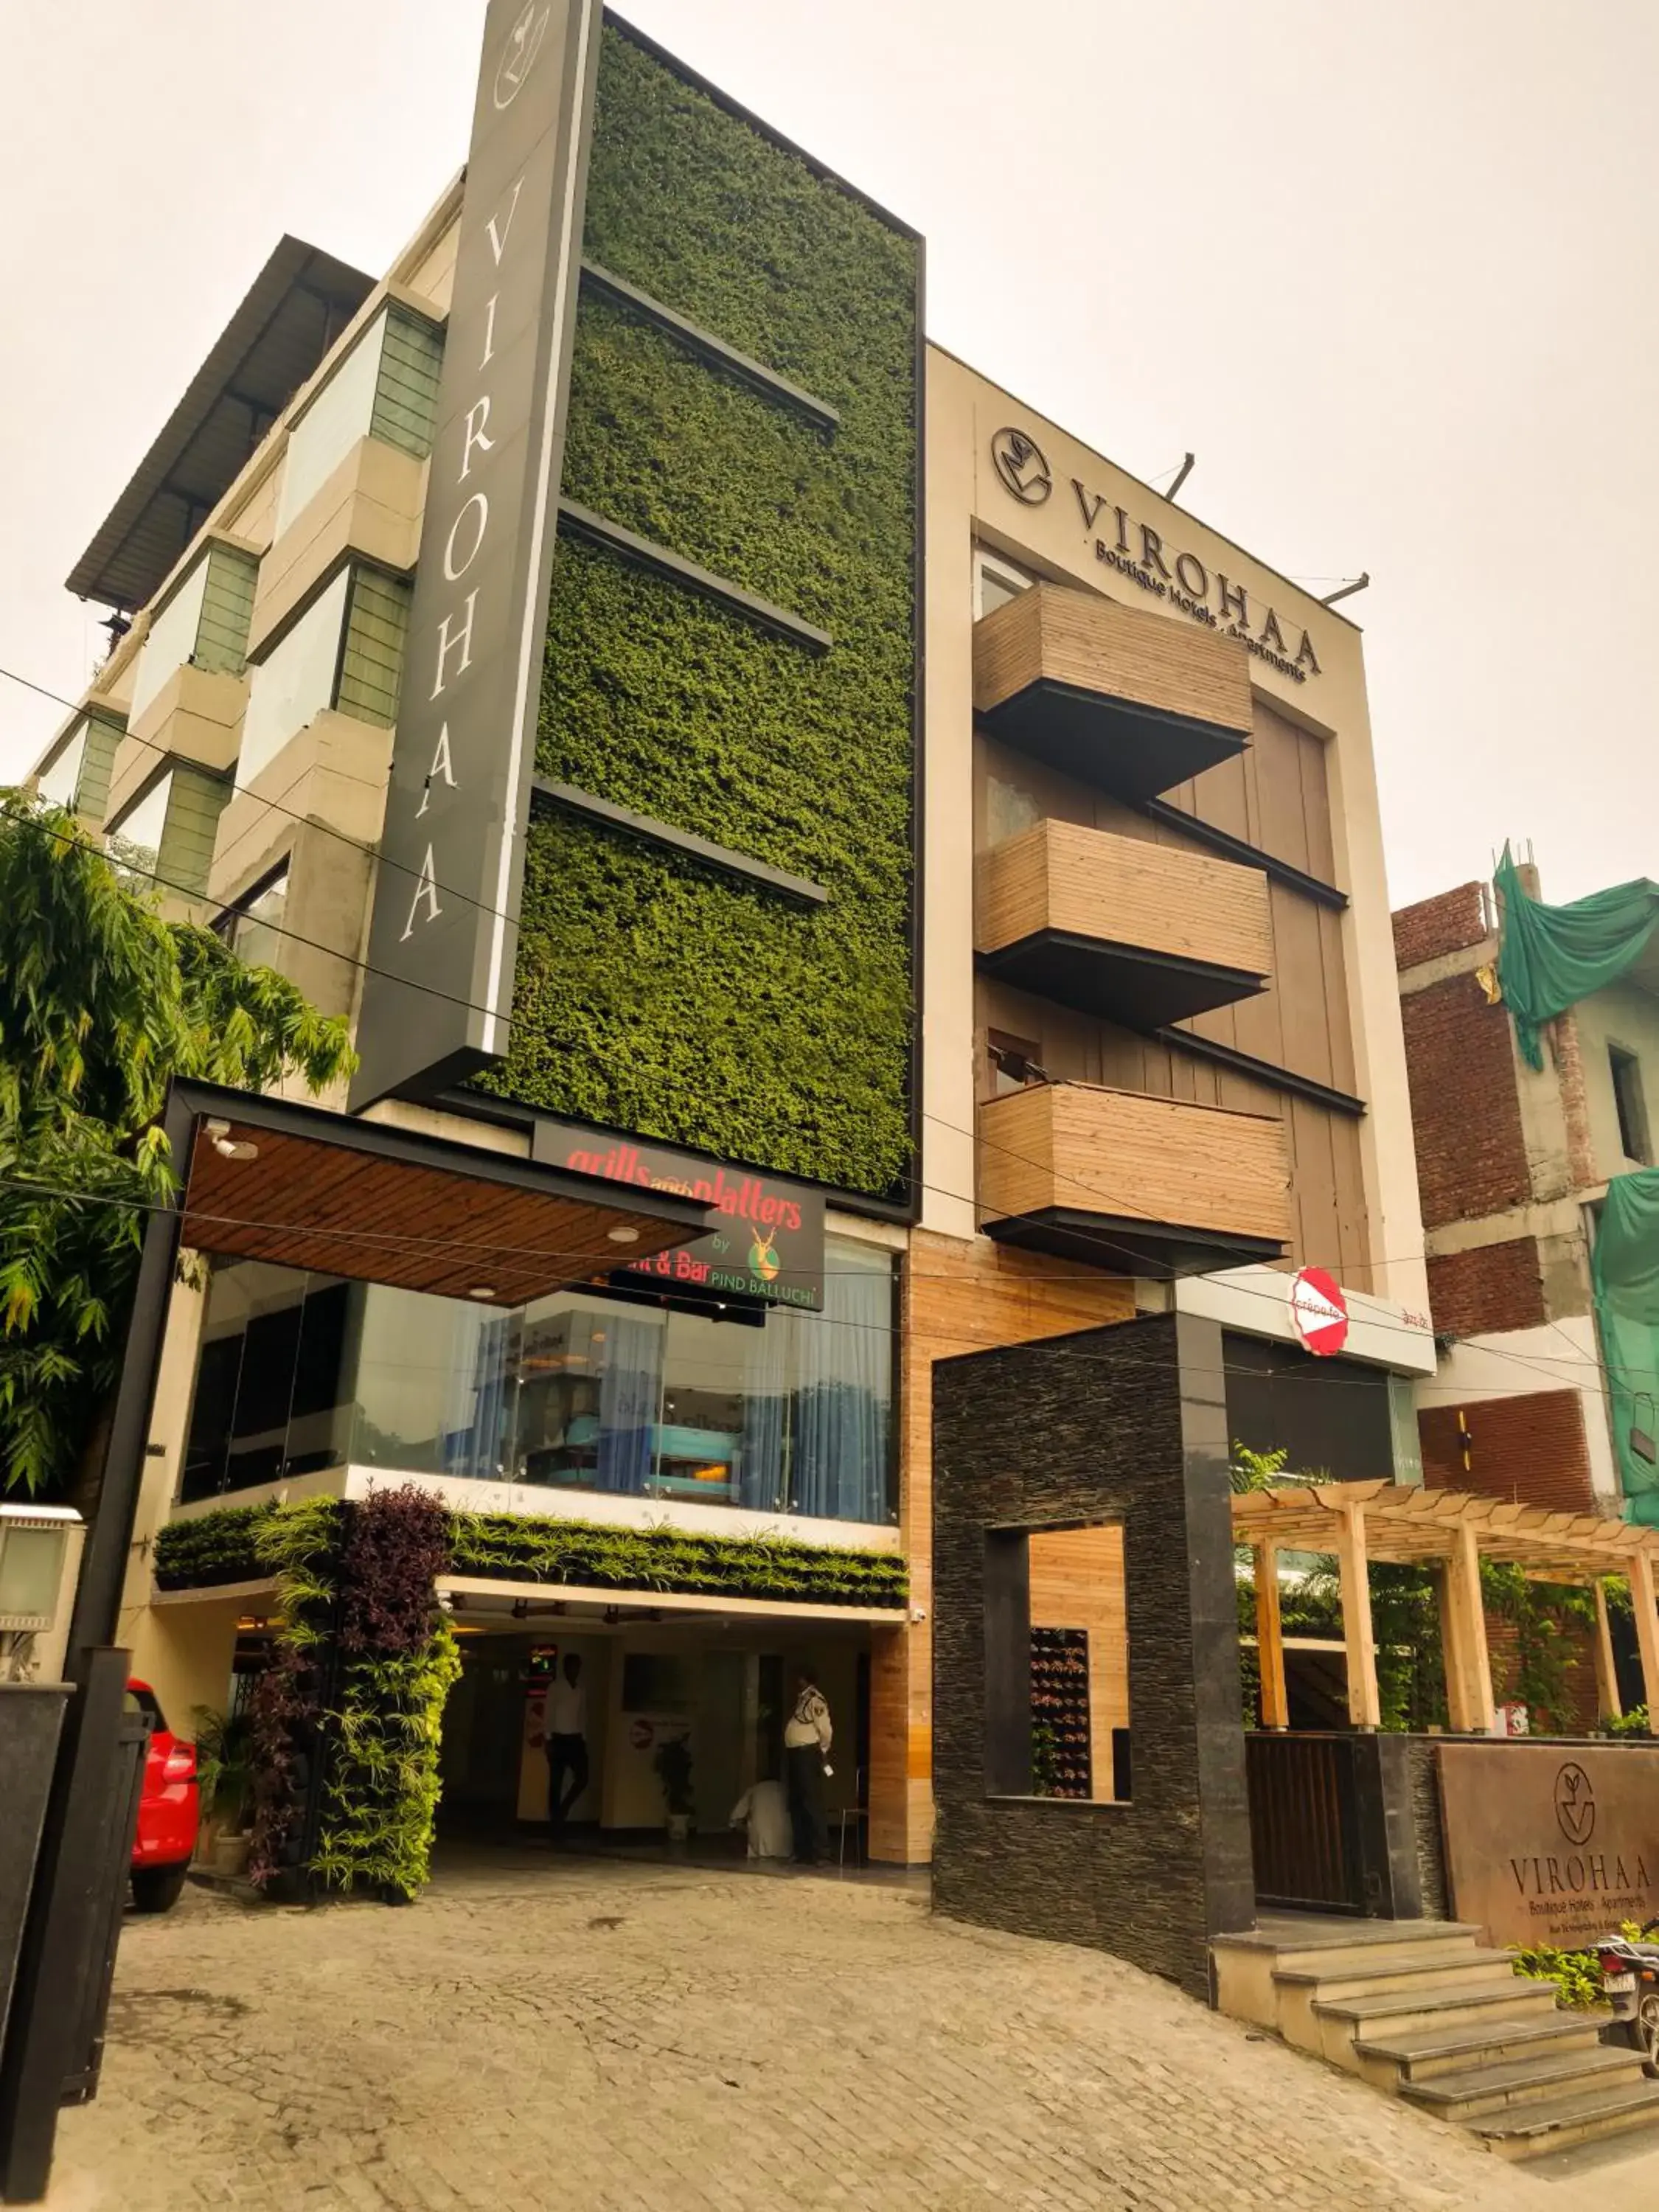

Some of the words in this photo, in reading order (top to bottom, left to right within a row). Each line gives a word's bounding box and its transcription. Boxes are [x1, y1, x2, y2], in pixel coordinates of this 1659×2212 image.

[399, 175, 526, 942] VIROHAA
[1071, 477, 1322, 675] VIROHAA
[1096, 538, 1167, 597] Boutique
[1169, 585, 1217, 629] Hotels
[1227, 623, 1307, 684] Apartments
[712, 1234, 730, 1254] by
[655, 1251, 672, 1276] &
[675, 1251, 712, 1283] Bar
[711, 1271, 746, 1292] PIND
[749, 1279, 816, 1305] BALLUCHI
[1509, 1854, 1651, 1896] VIROHAA
[1528, 1899, 1567, 1917] Boutique
[1569, 1898, 1596, 1913] Hotels
[1601, 1895, 1646, 1913] Apartments
